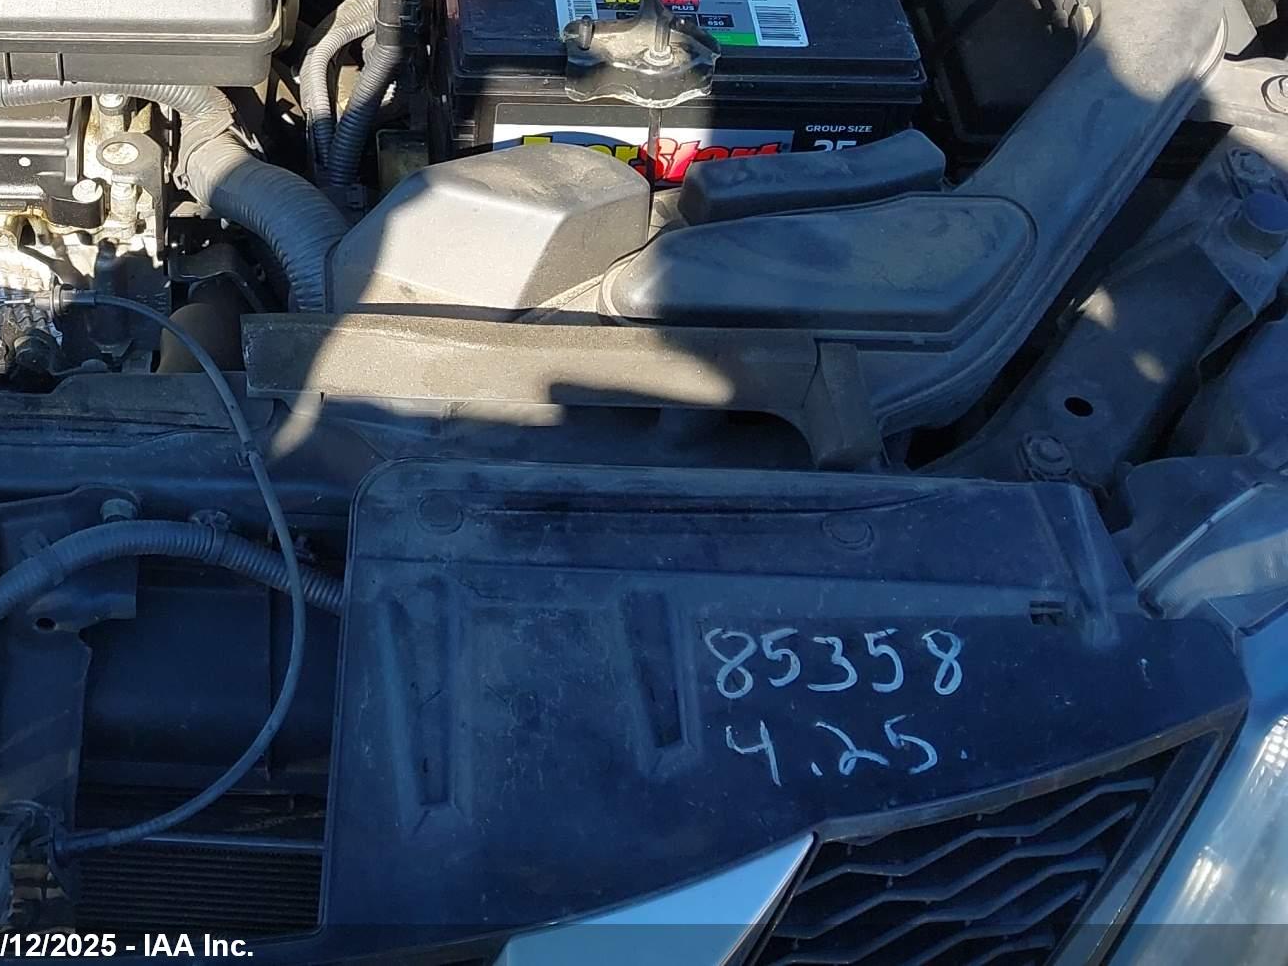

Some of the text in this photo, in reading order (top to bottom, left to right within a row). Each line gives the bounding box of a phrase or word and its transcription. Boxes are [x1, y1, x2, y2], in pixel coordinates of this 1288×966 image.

[805, 124, 873, 133] GROUP SIZE
[704, 627, 963, 699] 85358
